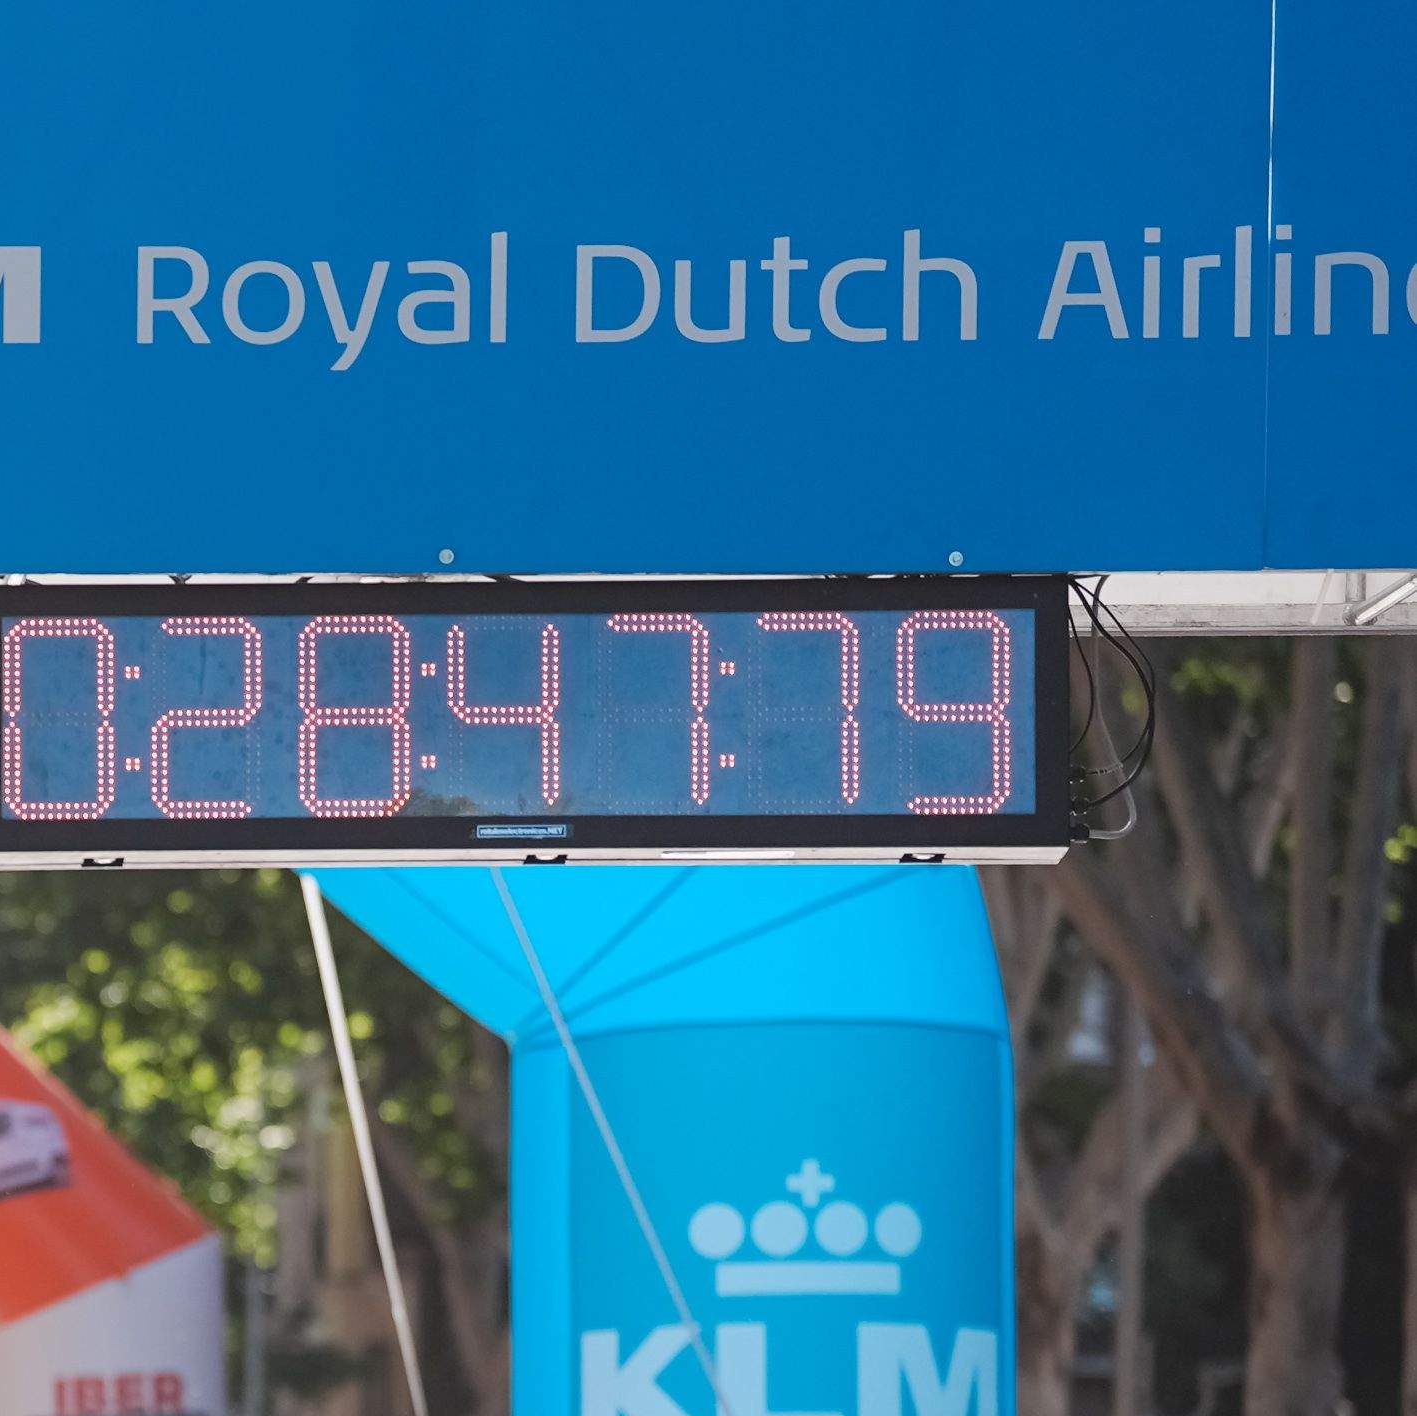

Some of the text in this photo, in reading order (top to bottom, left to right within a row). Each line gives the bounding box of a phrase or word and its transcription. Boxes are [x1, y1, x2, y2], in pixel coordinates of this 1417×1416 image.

[137, 224, 1417, 371] Royal Dutch Airlin
[4, 610, 1011, 820] 0:28:47:79
